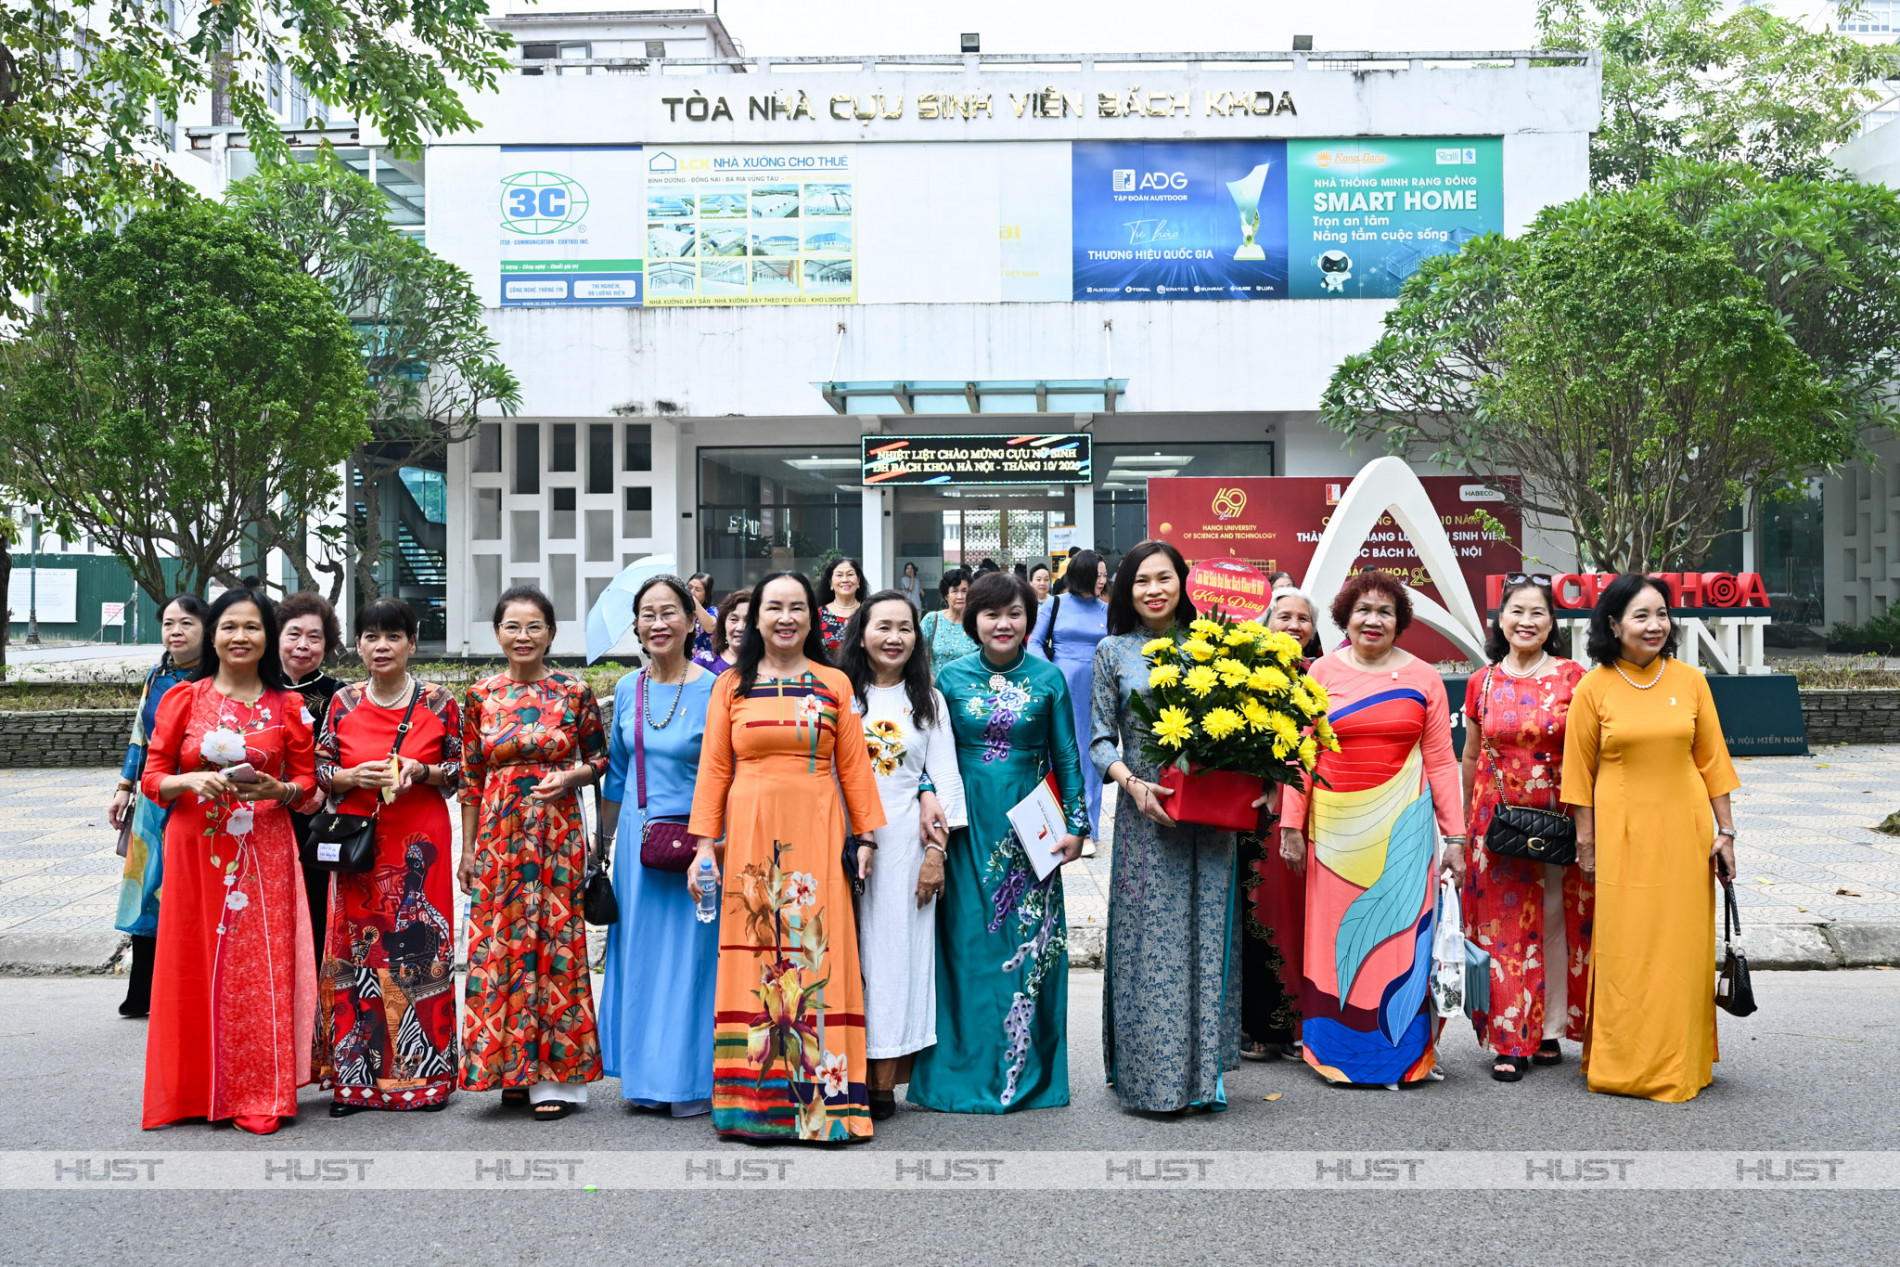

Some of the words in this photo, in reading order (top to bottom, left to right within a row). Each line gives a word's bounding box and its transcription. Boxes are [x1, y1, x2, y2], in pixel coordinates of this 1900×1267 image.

[661, 89, 734, 121] TÒA
[749, 89, 816, 121] NHÀ
[917, 93, 993, 120] SINH
[1007, 87, 1083, 118] VIÊN
[1098, 86, 1191, 118] BÁCH
[1204, 91, 1298, 117] KHOA
[679, 159, 710, 171] LCK
[713, 155, 739, 168] NHÀ
[788, 156, 815, 167] CHO
[817, 154, 849, 167] THUÊ
[1139, 171, 1189, 190] ADG
[1314, 177, 1337, 187] NHÀ
[1339, 176, 1378, 187] THÔNG
[1380, 178, 1409, 187] MINH
[1412, 177, 1442, 188] RẠNG
[1444, 174, 1477, 186] ĐÔNG
[509, 187, 566, 218] 3C
[1149, 194, 1188, 202] AUSTDOOR
[1313, 191, 1397, 213] SMART
[1404, 189, 1478, 211] HOME
[1312, 215, 1340, 229] Trọn
[1343, 217, 1361, 226] an
[1364, 214, 1390, 226] tâm
[1312, 229, 1348, 244] Nâng
[1351, 227, 1378, 241] tầm
[1380, 229, 1414, 243] cuộc
[1417, 227, 1448, 242] sống
[1087, 249, 1133, 260] THƯƠNG
[1135, 248, 1161, 262] HIỆU
[1163, 246, 1193, 260] QUỐC
[1194, 249, 1215, 260] GIA
[877, 449, 911, 462] NHIỆT
[911, 449, 936, 462] LIỆT
[937, 447, 969, 460] CHÀO
[970, 447, 1005, 459] MỪNG
[1006, 448, 1031, 461] CỰU
[1032, 446, 1050, 459] NỮ
[1050, 448, 1077, 458] SINH
[873, 462, 889, 473] ĐH
[890, 460, 922, 472] BÁCH
[923, 461, 955, 472] KHOA
[956, 460, 974, 472] HÀ
[975, 460, 995, 473] NỘI
[1002, 460, 1041, 471] THÁNG
[1211, 487, 1248, 519] 69
[1452, 531, 1479, 541] SINH
[1372, 545, 1404, 558] BÁCH
[1461, 545, 1483, 559] NỘI
[1192, 588, 1225, 604] Kính
[1783, 736, 1804, 744] NAM
